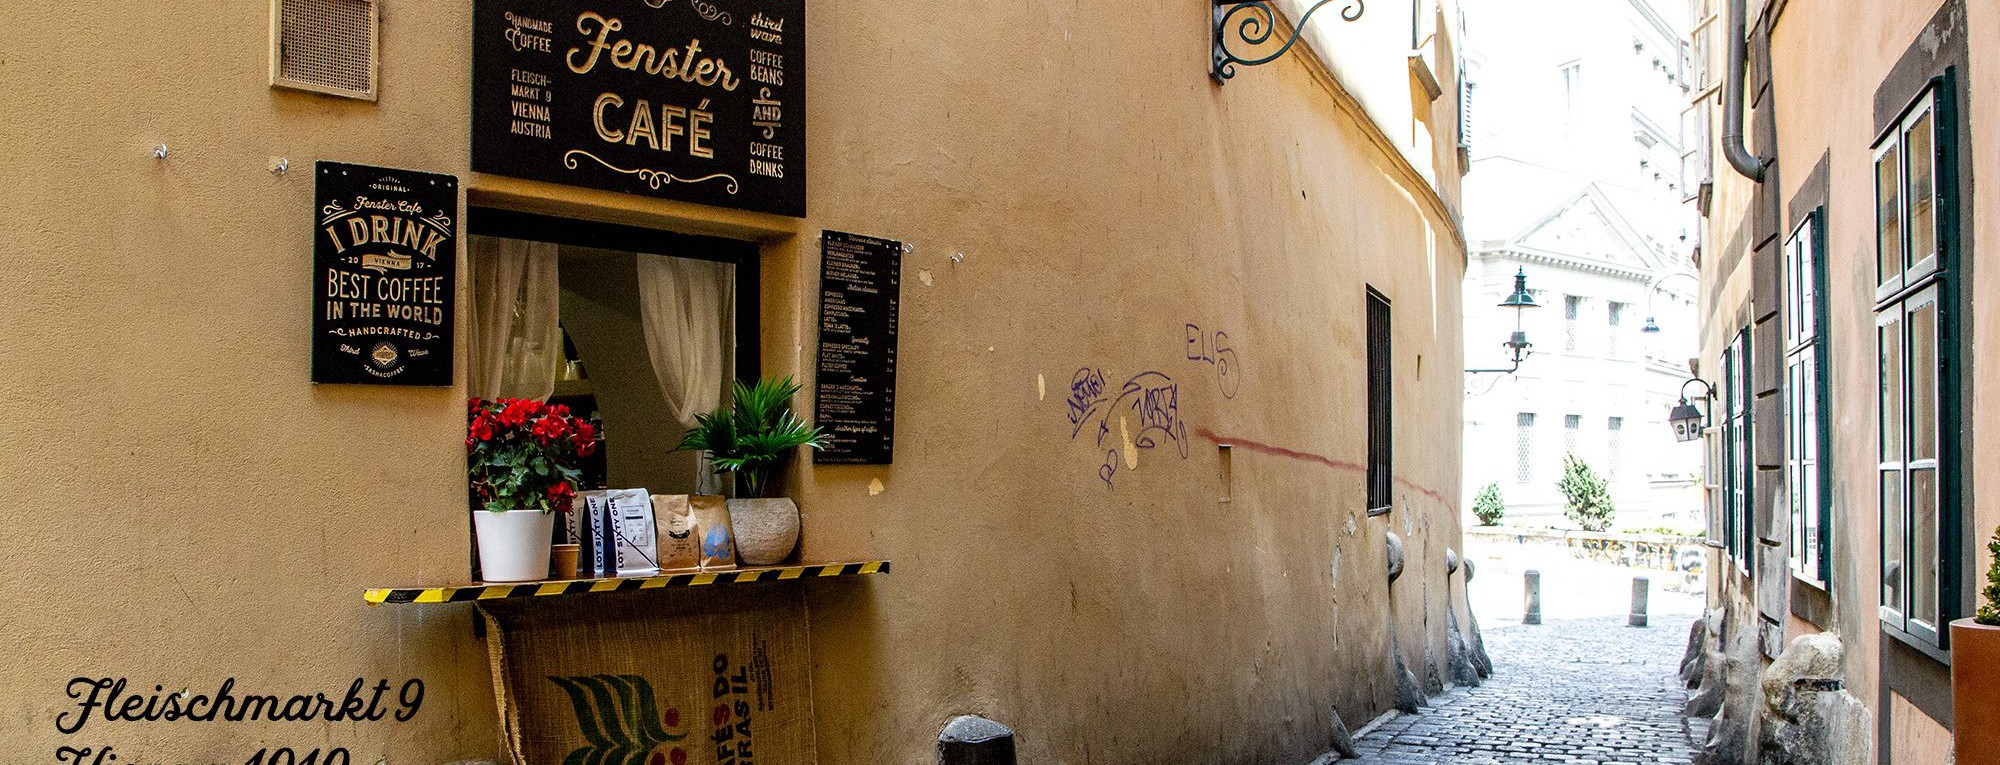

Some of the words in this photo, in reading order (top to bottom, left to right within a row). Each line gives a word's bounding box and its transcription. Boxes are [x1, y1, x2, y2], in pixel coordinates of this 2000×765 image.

[505, 12, 552, 33] HANDMADE
[751, 13, 783, 31] third
[505, 26, 552, 52] COFFEE
[750, 28, 782, 45] wave
[566, 11, 739, 91] Fenster
[750, 50, 783, 69] COFFEE
[511, 69, 552, 86] FLEISCH-
[750, 66, 783, 86] BEANS
[511, 84, 540, 100] MARKT
[546, 91, 552, 102] 9
[511, 102, 551, 122] VIENNA
[753, 105, 781, 121] AND
[511, 121, 552, 140] AUSTRIA
[593, 93, 714, 159] CAFÉ
[750, 142, 784, 160] COFFEE
[750, 159, 784, 178] DRINKS
[354, 196, 397, 212] Fenster
[398, 199, 422, 214] Cafe
[326, 225, 346, 254] I
[348, 215, 446, 262] DRINK
[374, 257, 400, 266] VIENNA
[328, 268, 370, 300] BEST
[378, 276, 443, 304] COFFEE
[326, 300, 343, 320] IN
[350, 302, 380, 318] THE
[387, 304, 442, 326] WORLD
[348, 326, 420, 340] HANDCRAFTED
[590, 498, 598, 516] ONE
[610, 496, 618, 516] ONE
[614, 519, 623, 548] SIXTY
[713, 652, 730, 700] DO
[55, 677, 392, 734] Fleischmarkt
[395, 678, 426, 722] 9
